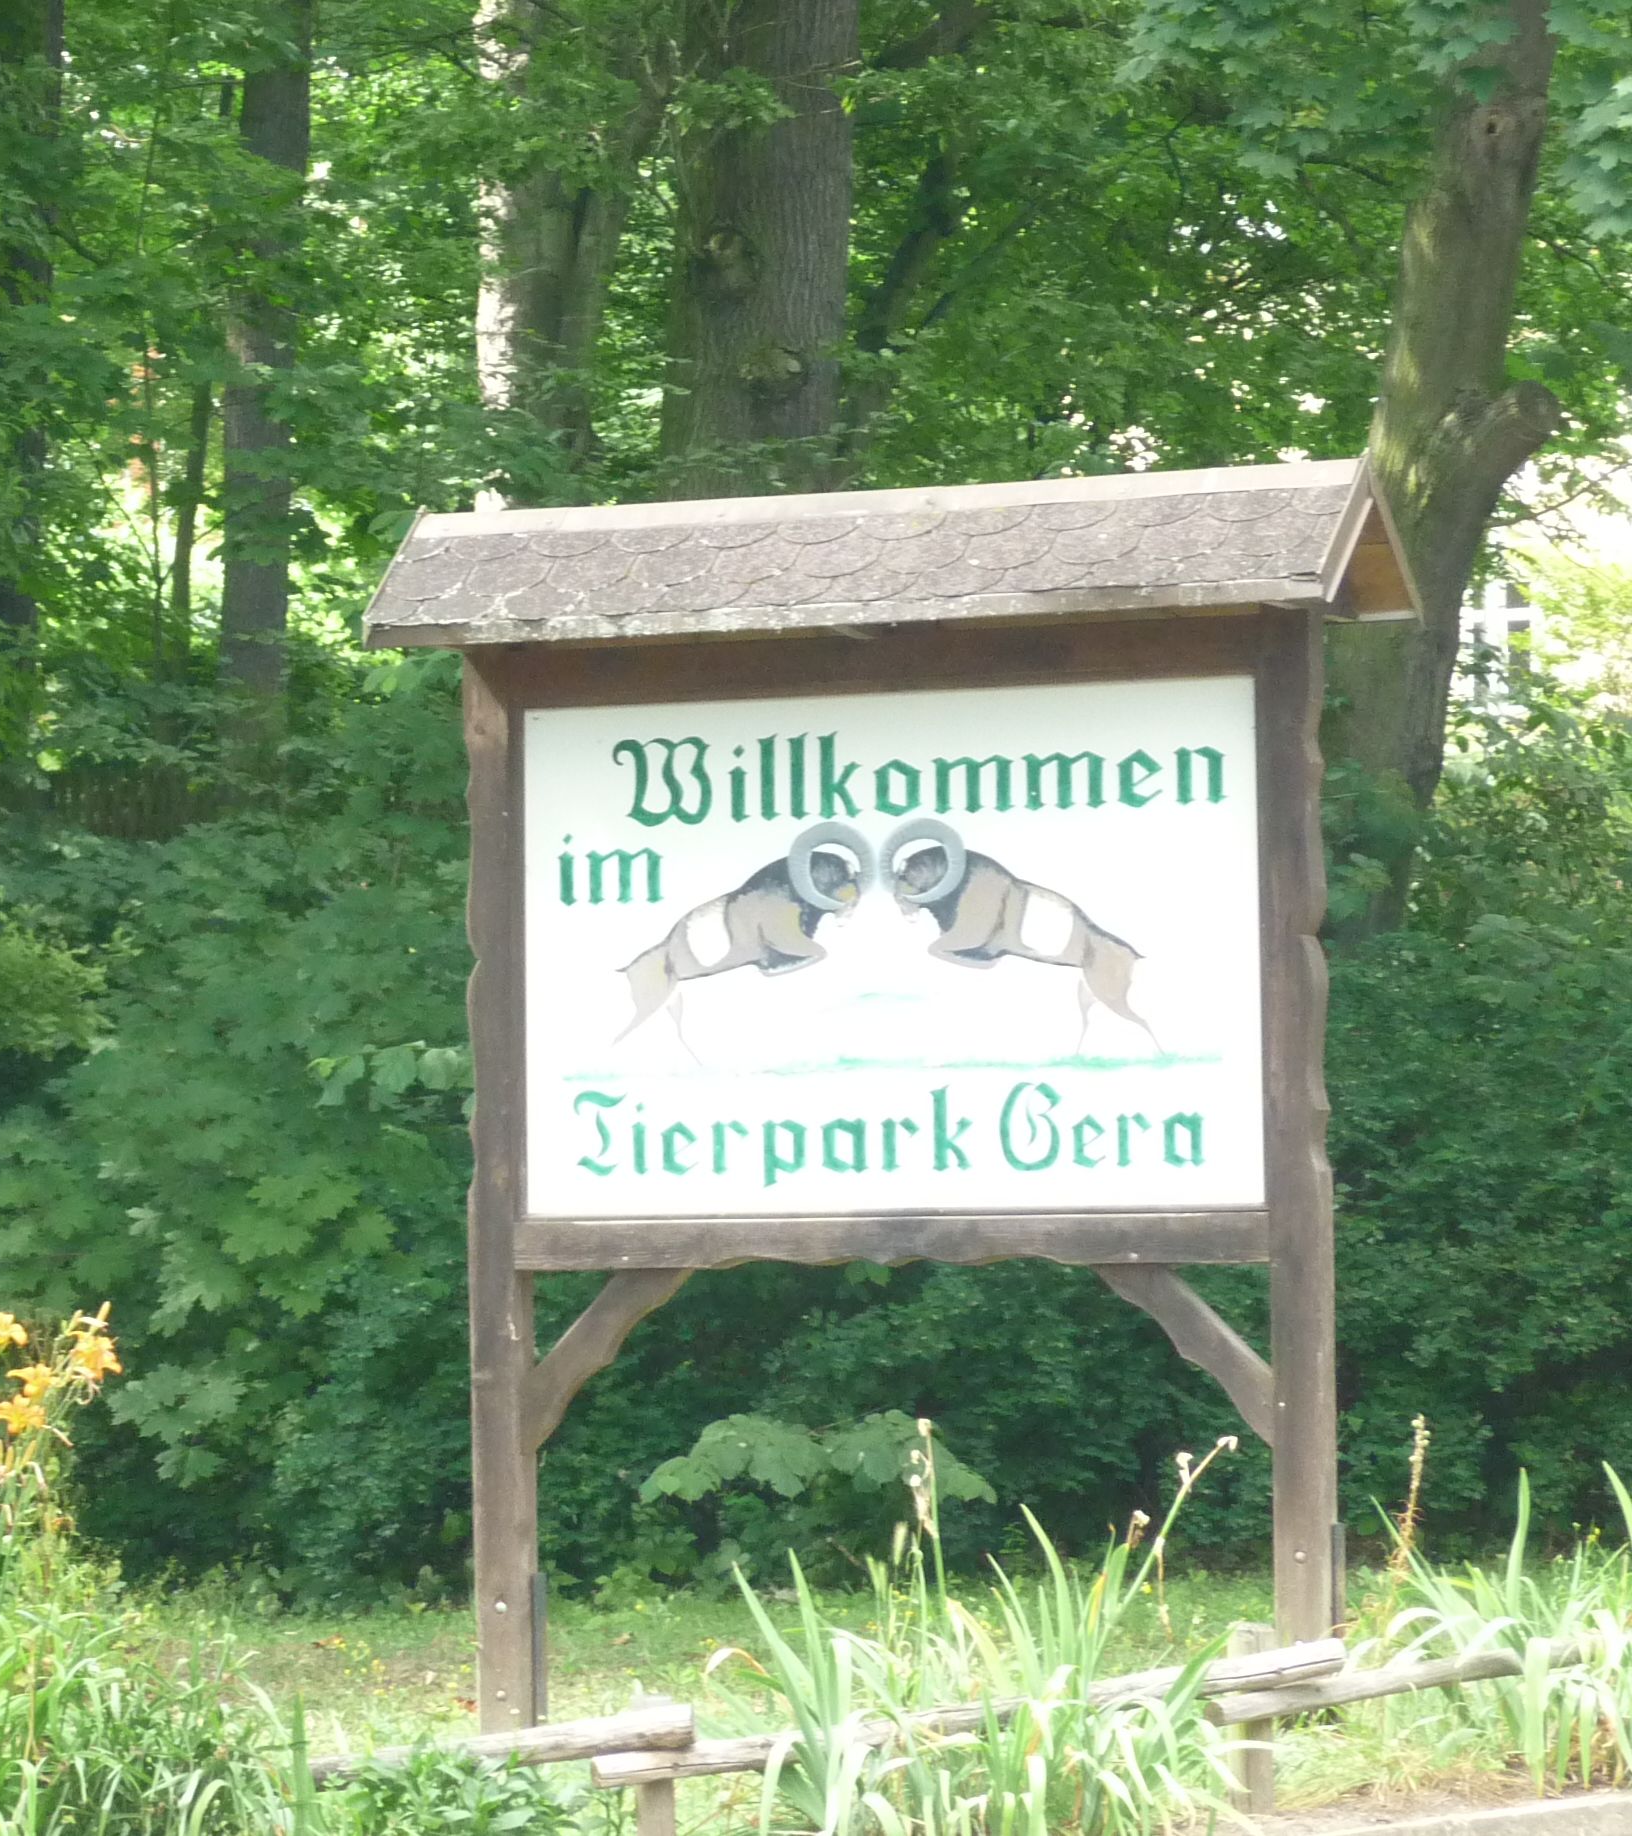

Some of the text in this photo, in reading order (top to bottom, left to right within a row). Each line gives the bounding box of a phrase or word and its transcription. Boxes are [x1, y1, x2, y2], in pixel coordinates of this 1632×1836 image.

[613, 732, 1227, 827] Willkommen
[557, 835, 664, 906] im
[574, 1082, 1206, 1187] Tierpark Gera
